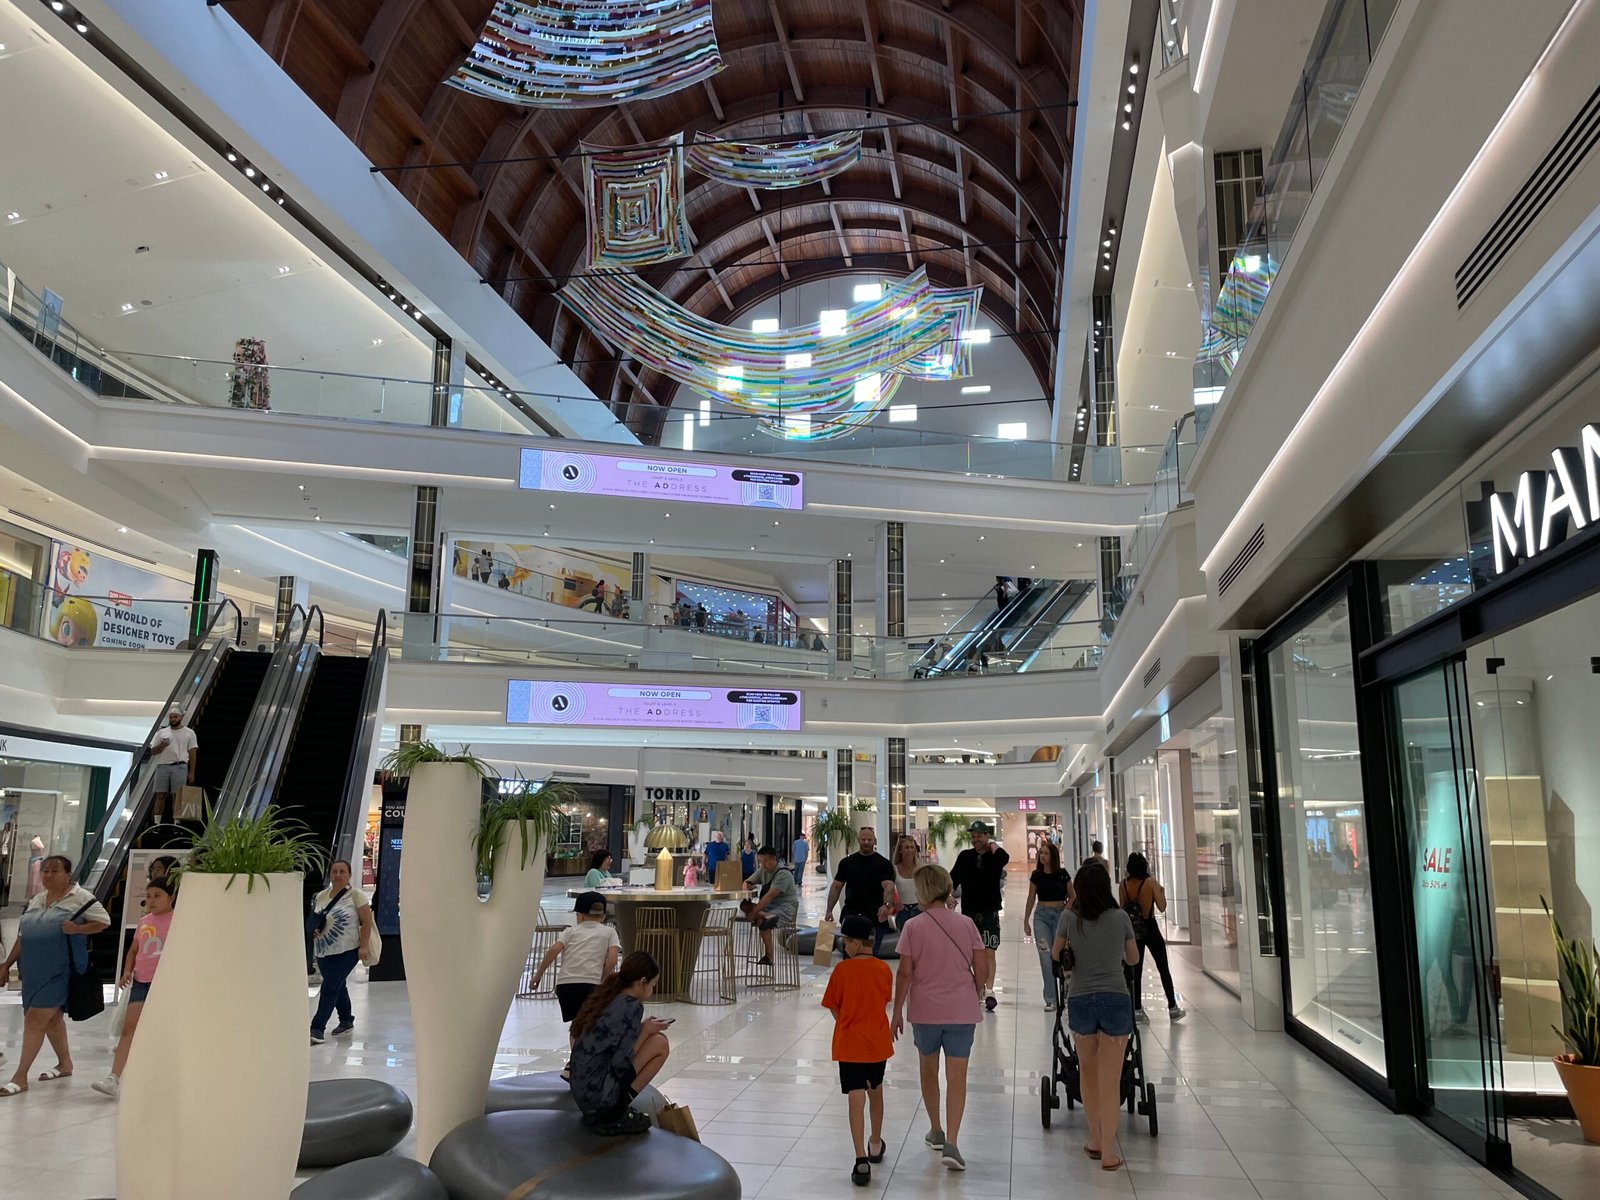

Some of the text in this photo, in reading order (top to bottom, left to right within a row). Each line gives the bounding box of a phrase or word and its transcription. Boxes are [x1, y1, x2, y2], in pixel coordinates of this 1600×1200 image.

[667, 466, 688, 474] OPEN
[627, 480, 707, 493] THE ADDRESS
[104, 607, 163, 629] A WORLD OF
[103, 621, 175, 646] DESIGNER TOYS
[102, 636, 146, 649] COMING SOON
[618, 707, 701, 717] THE ADDRESS
[645, 787, 701, 801] TORRID
[1423, 847, 1452, 873] SALE
